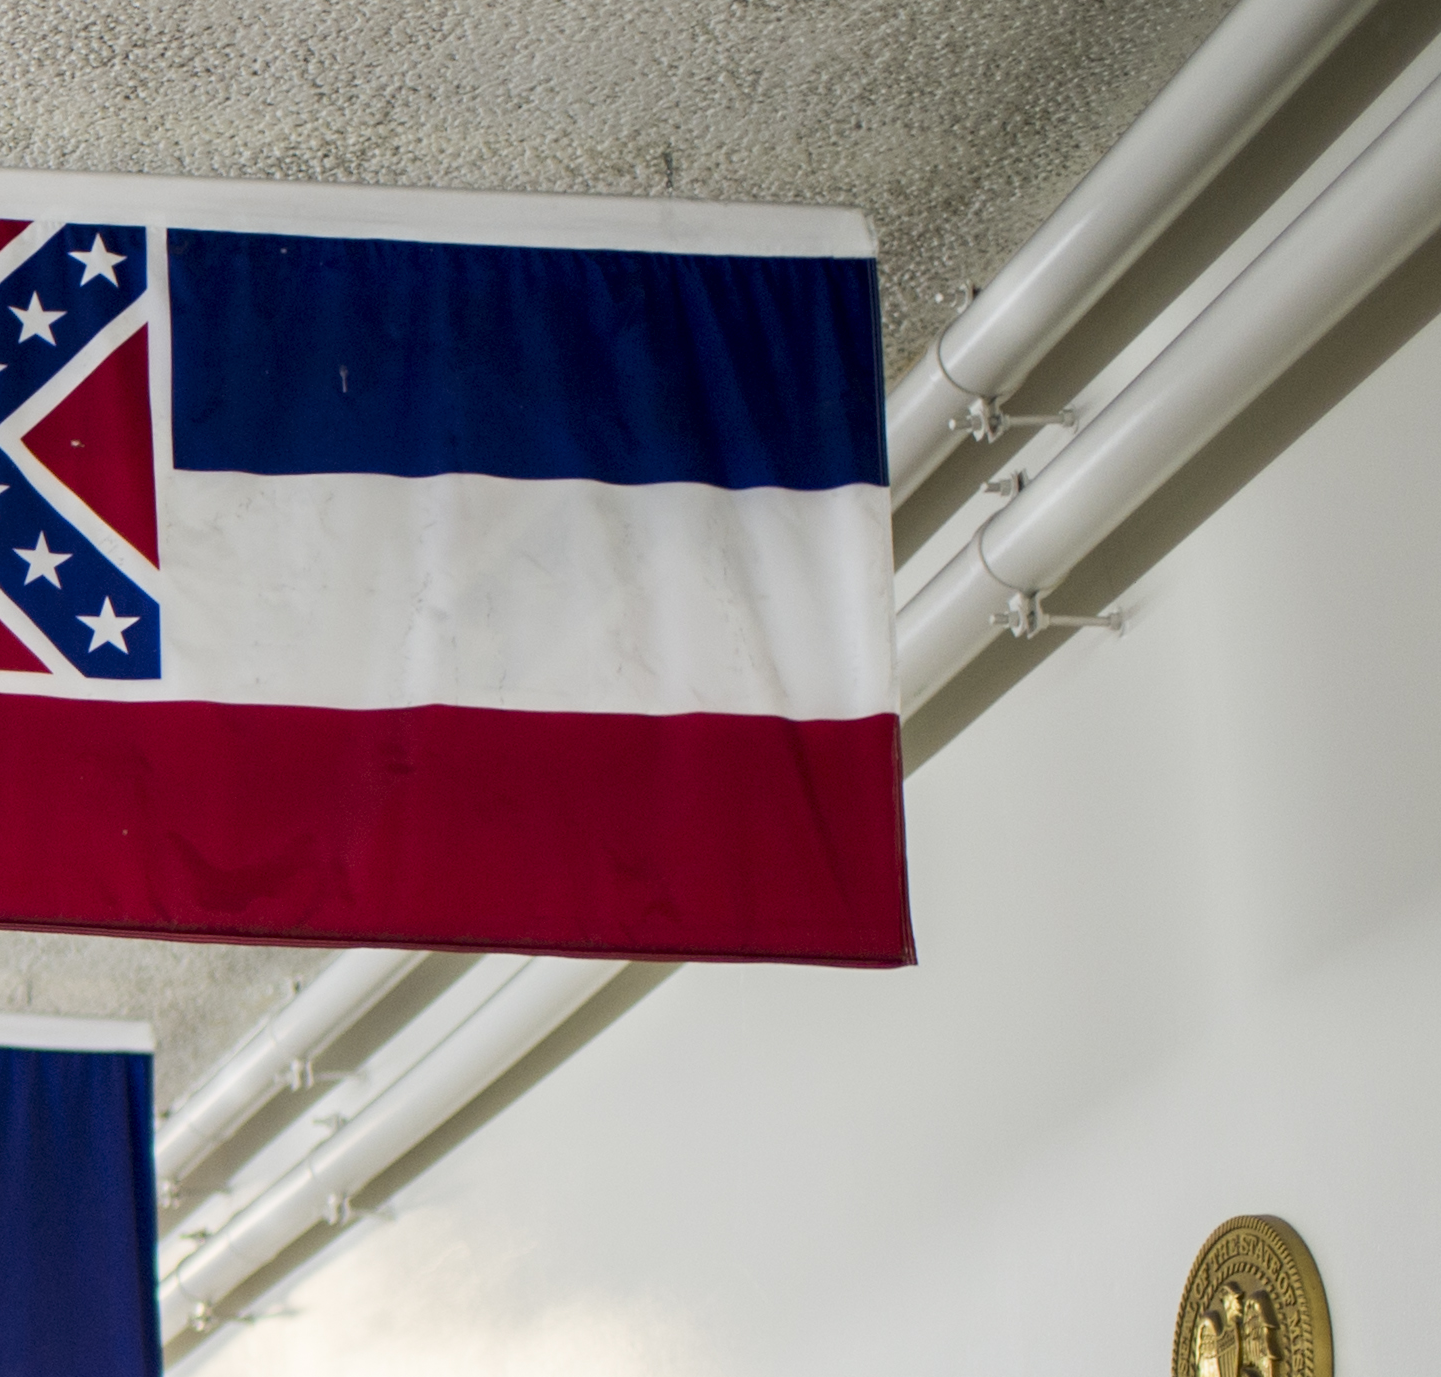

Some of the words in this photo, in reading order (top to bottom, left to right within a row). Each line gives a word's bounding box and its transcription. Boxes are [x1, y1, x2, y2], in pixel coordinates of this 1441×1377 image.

[1193, 1262, 1210, 1300] OF
[1211, 1235, 1240, 1273] THE
[1240, 1233, 1283, 1282] STATE
[1278, 1271, 1297, 1307] OF
